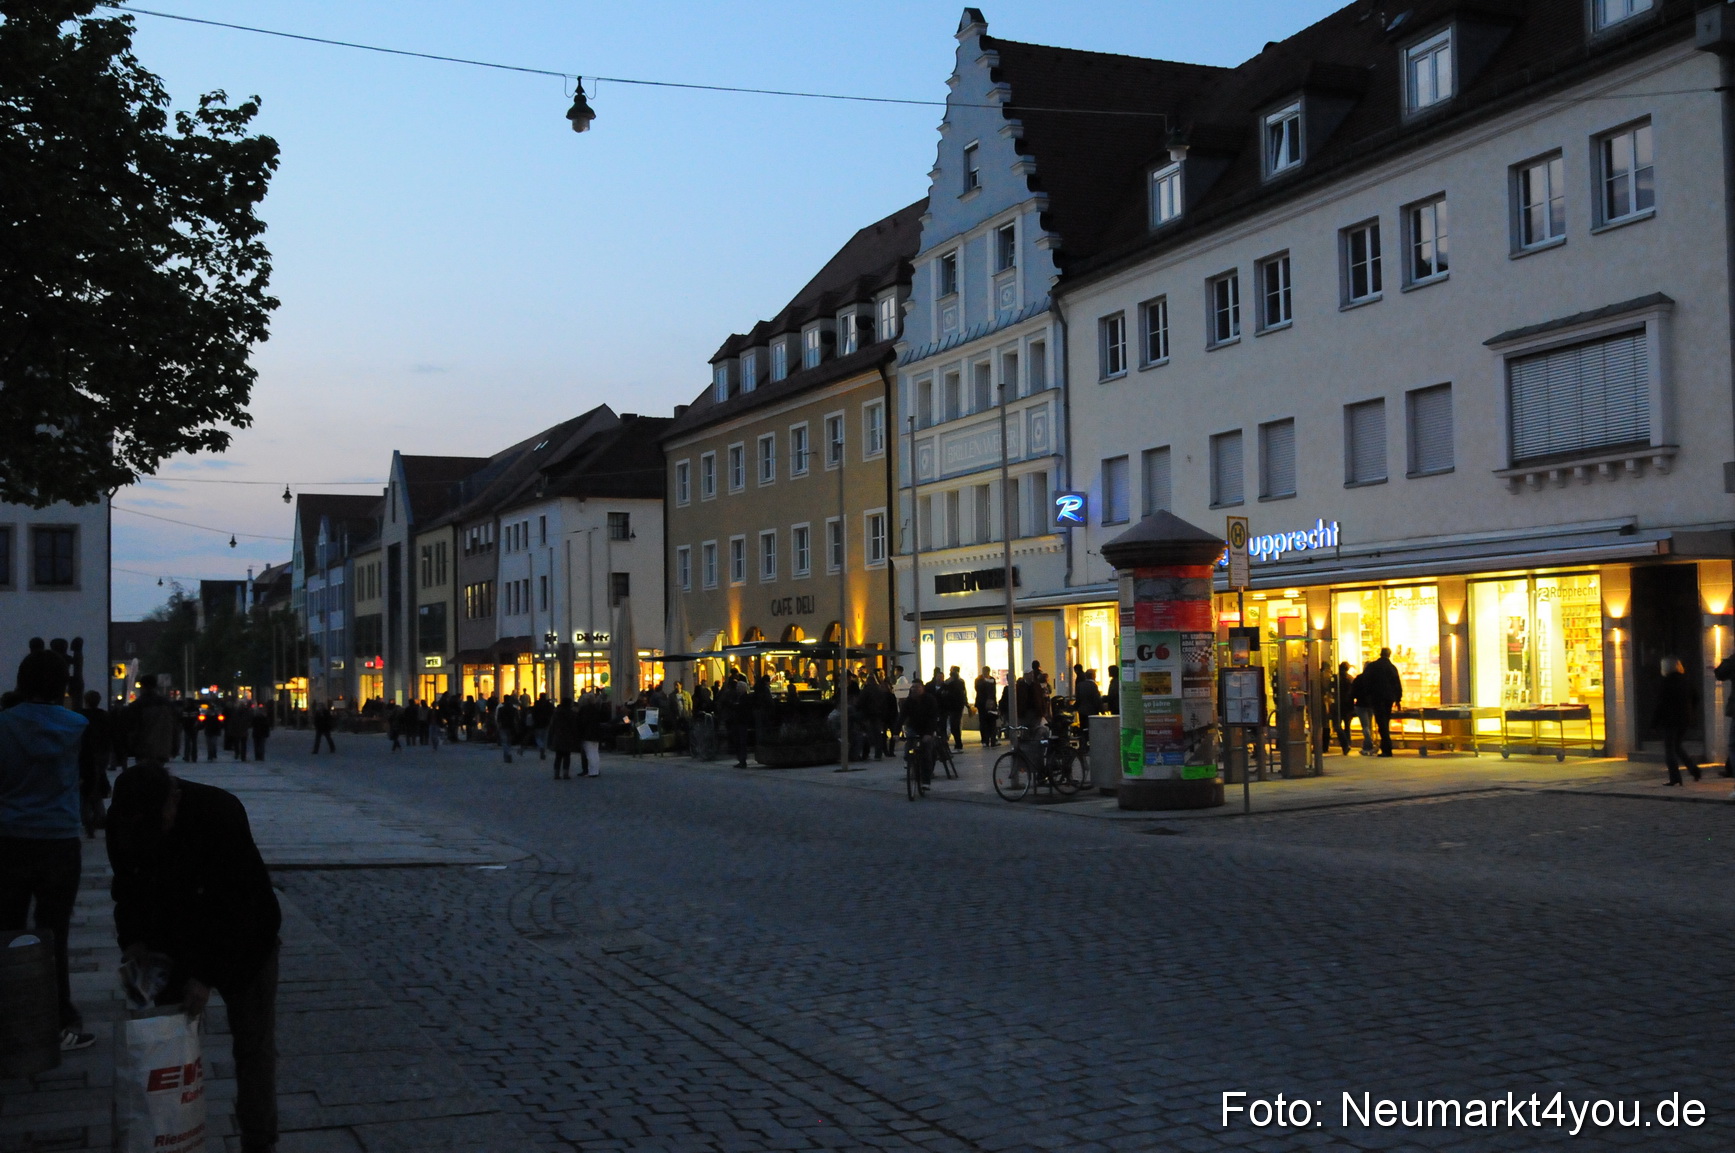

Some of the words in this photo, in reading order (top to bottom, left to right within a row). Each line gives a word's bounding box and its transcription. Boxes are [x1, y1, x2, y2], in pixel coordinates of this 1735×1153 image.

[1247, 518, 1340, 562] upprecht
[1550, 586, 1598, 601] Rupprecht
[771, 597, 793, 616] CAFE
[796, 595, 815, 614] DELI
[1137, 642, 1170, 661] G6
